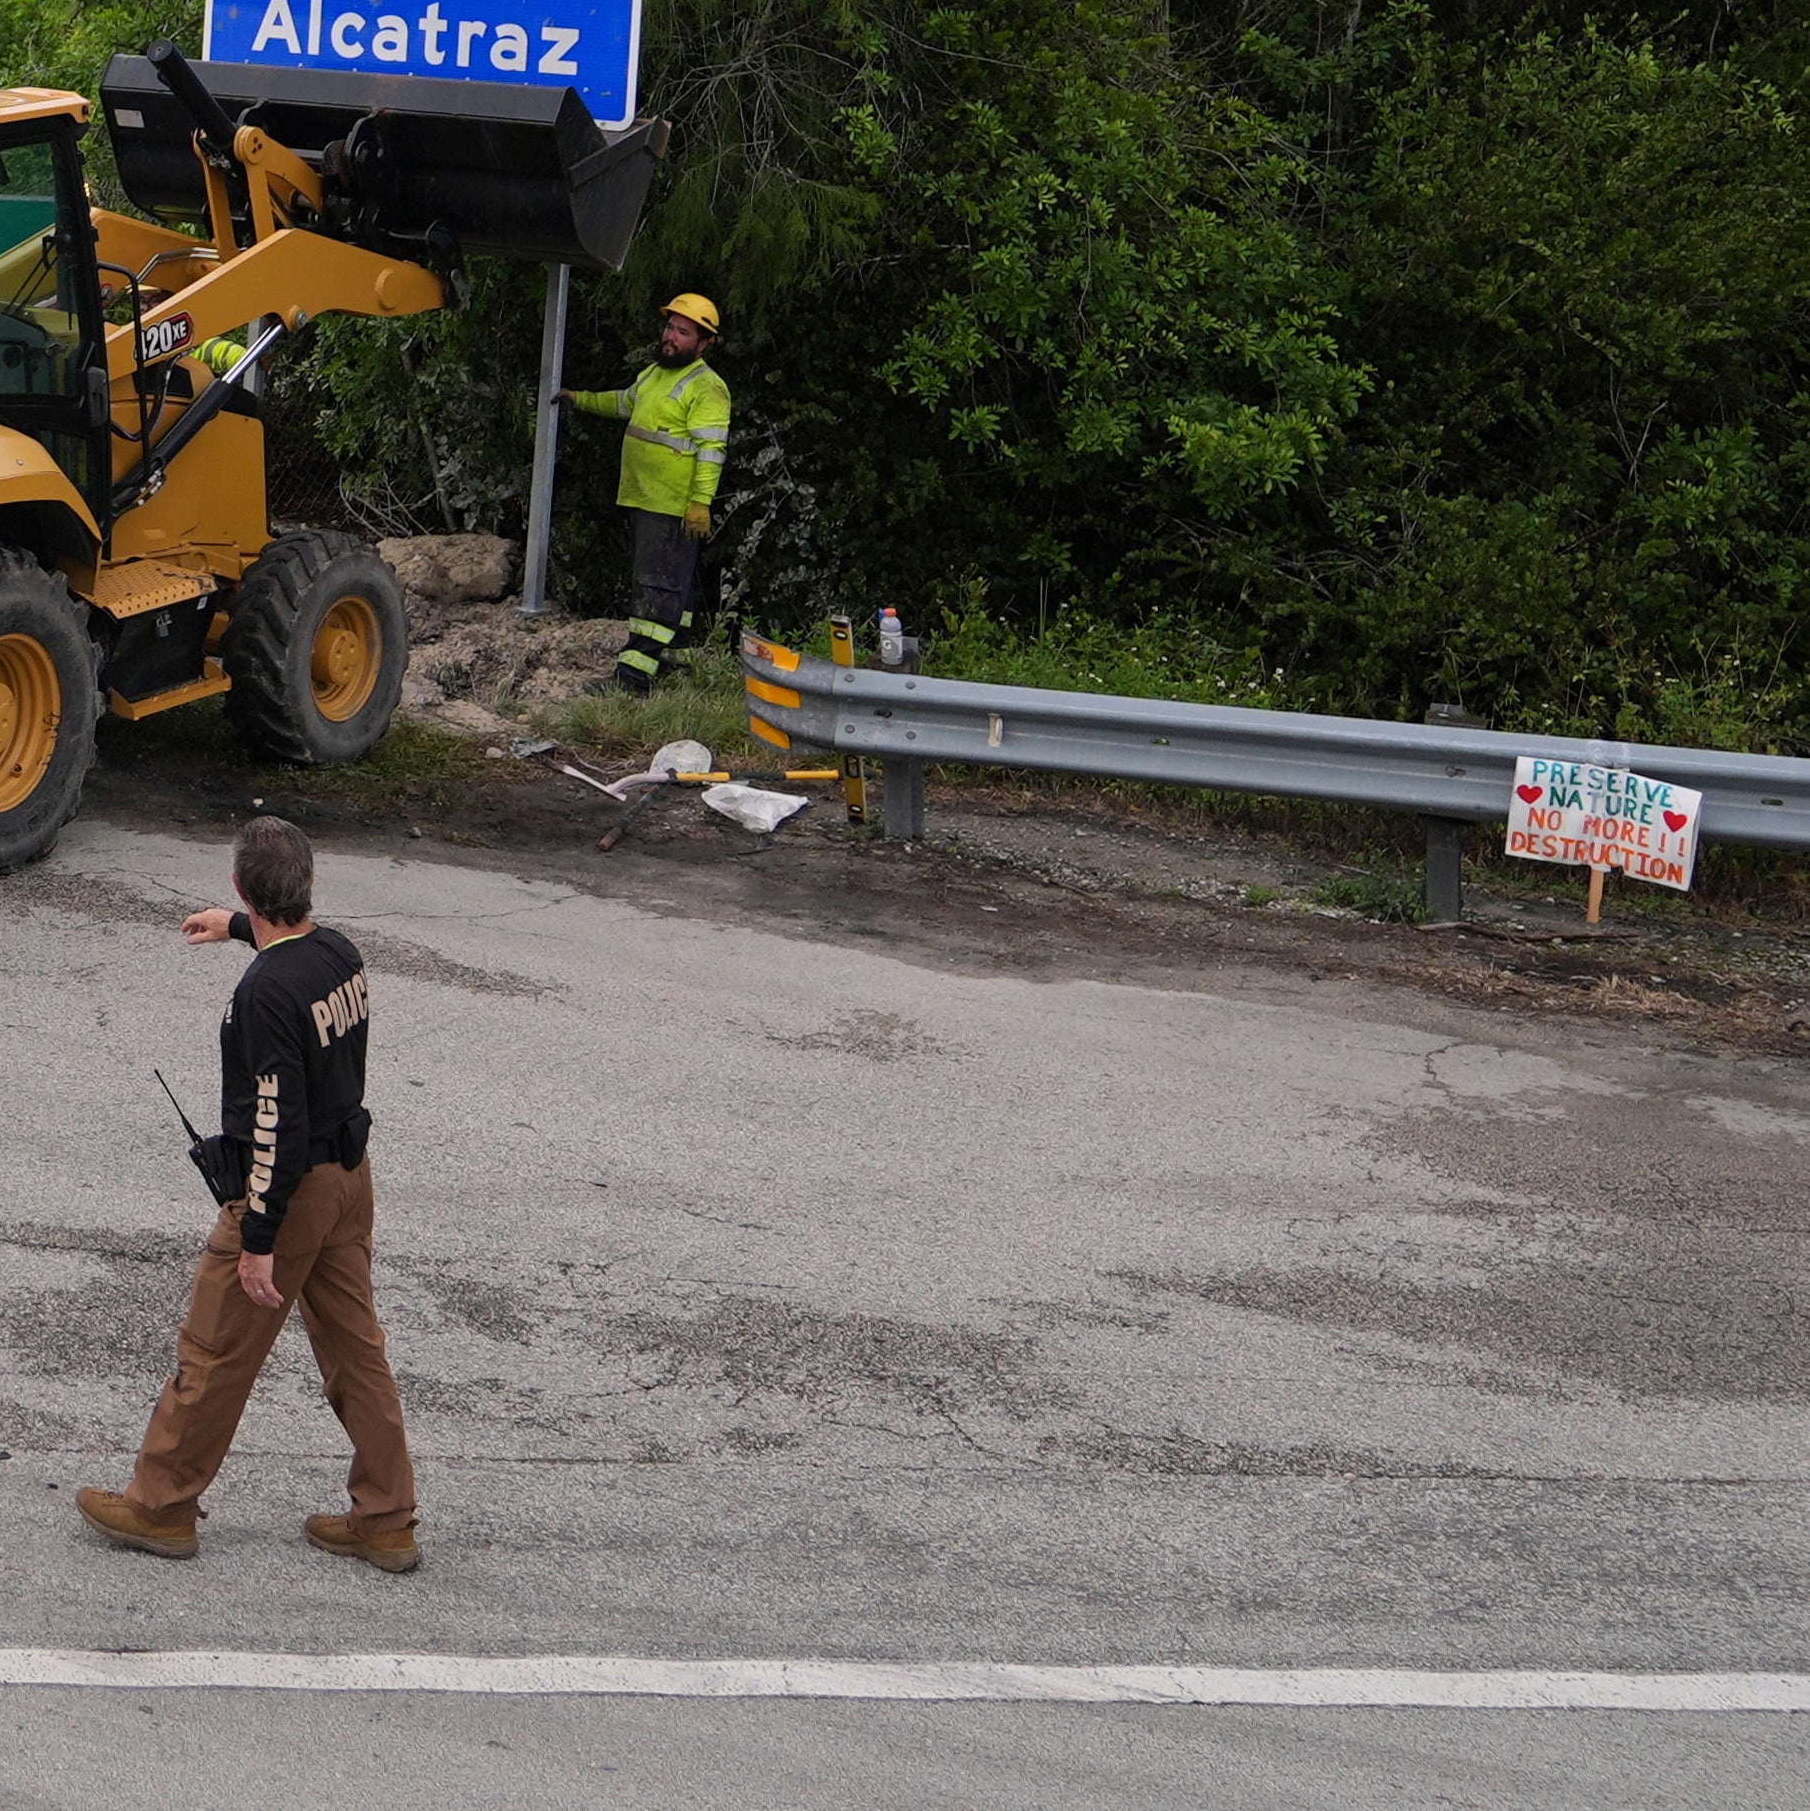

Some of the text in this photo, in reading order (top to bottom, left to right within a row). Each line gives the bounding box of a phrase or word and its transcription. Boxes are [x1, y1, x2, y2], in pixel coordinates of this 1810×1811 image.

[1532, 760, 1674, 808] PRESERVE
[1548, 786, 1654, 825] NATURE
[1527, 806, 1562, 831] NO
[1510, 831, 1684, 885] DESTRUCTION
[310, 969, 368, 1048] POLIC
[249, 1073, 279, 1215] POLICE
